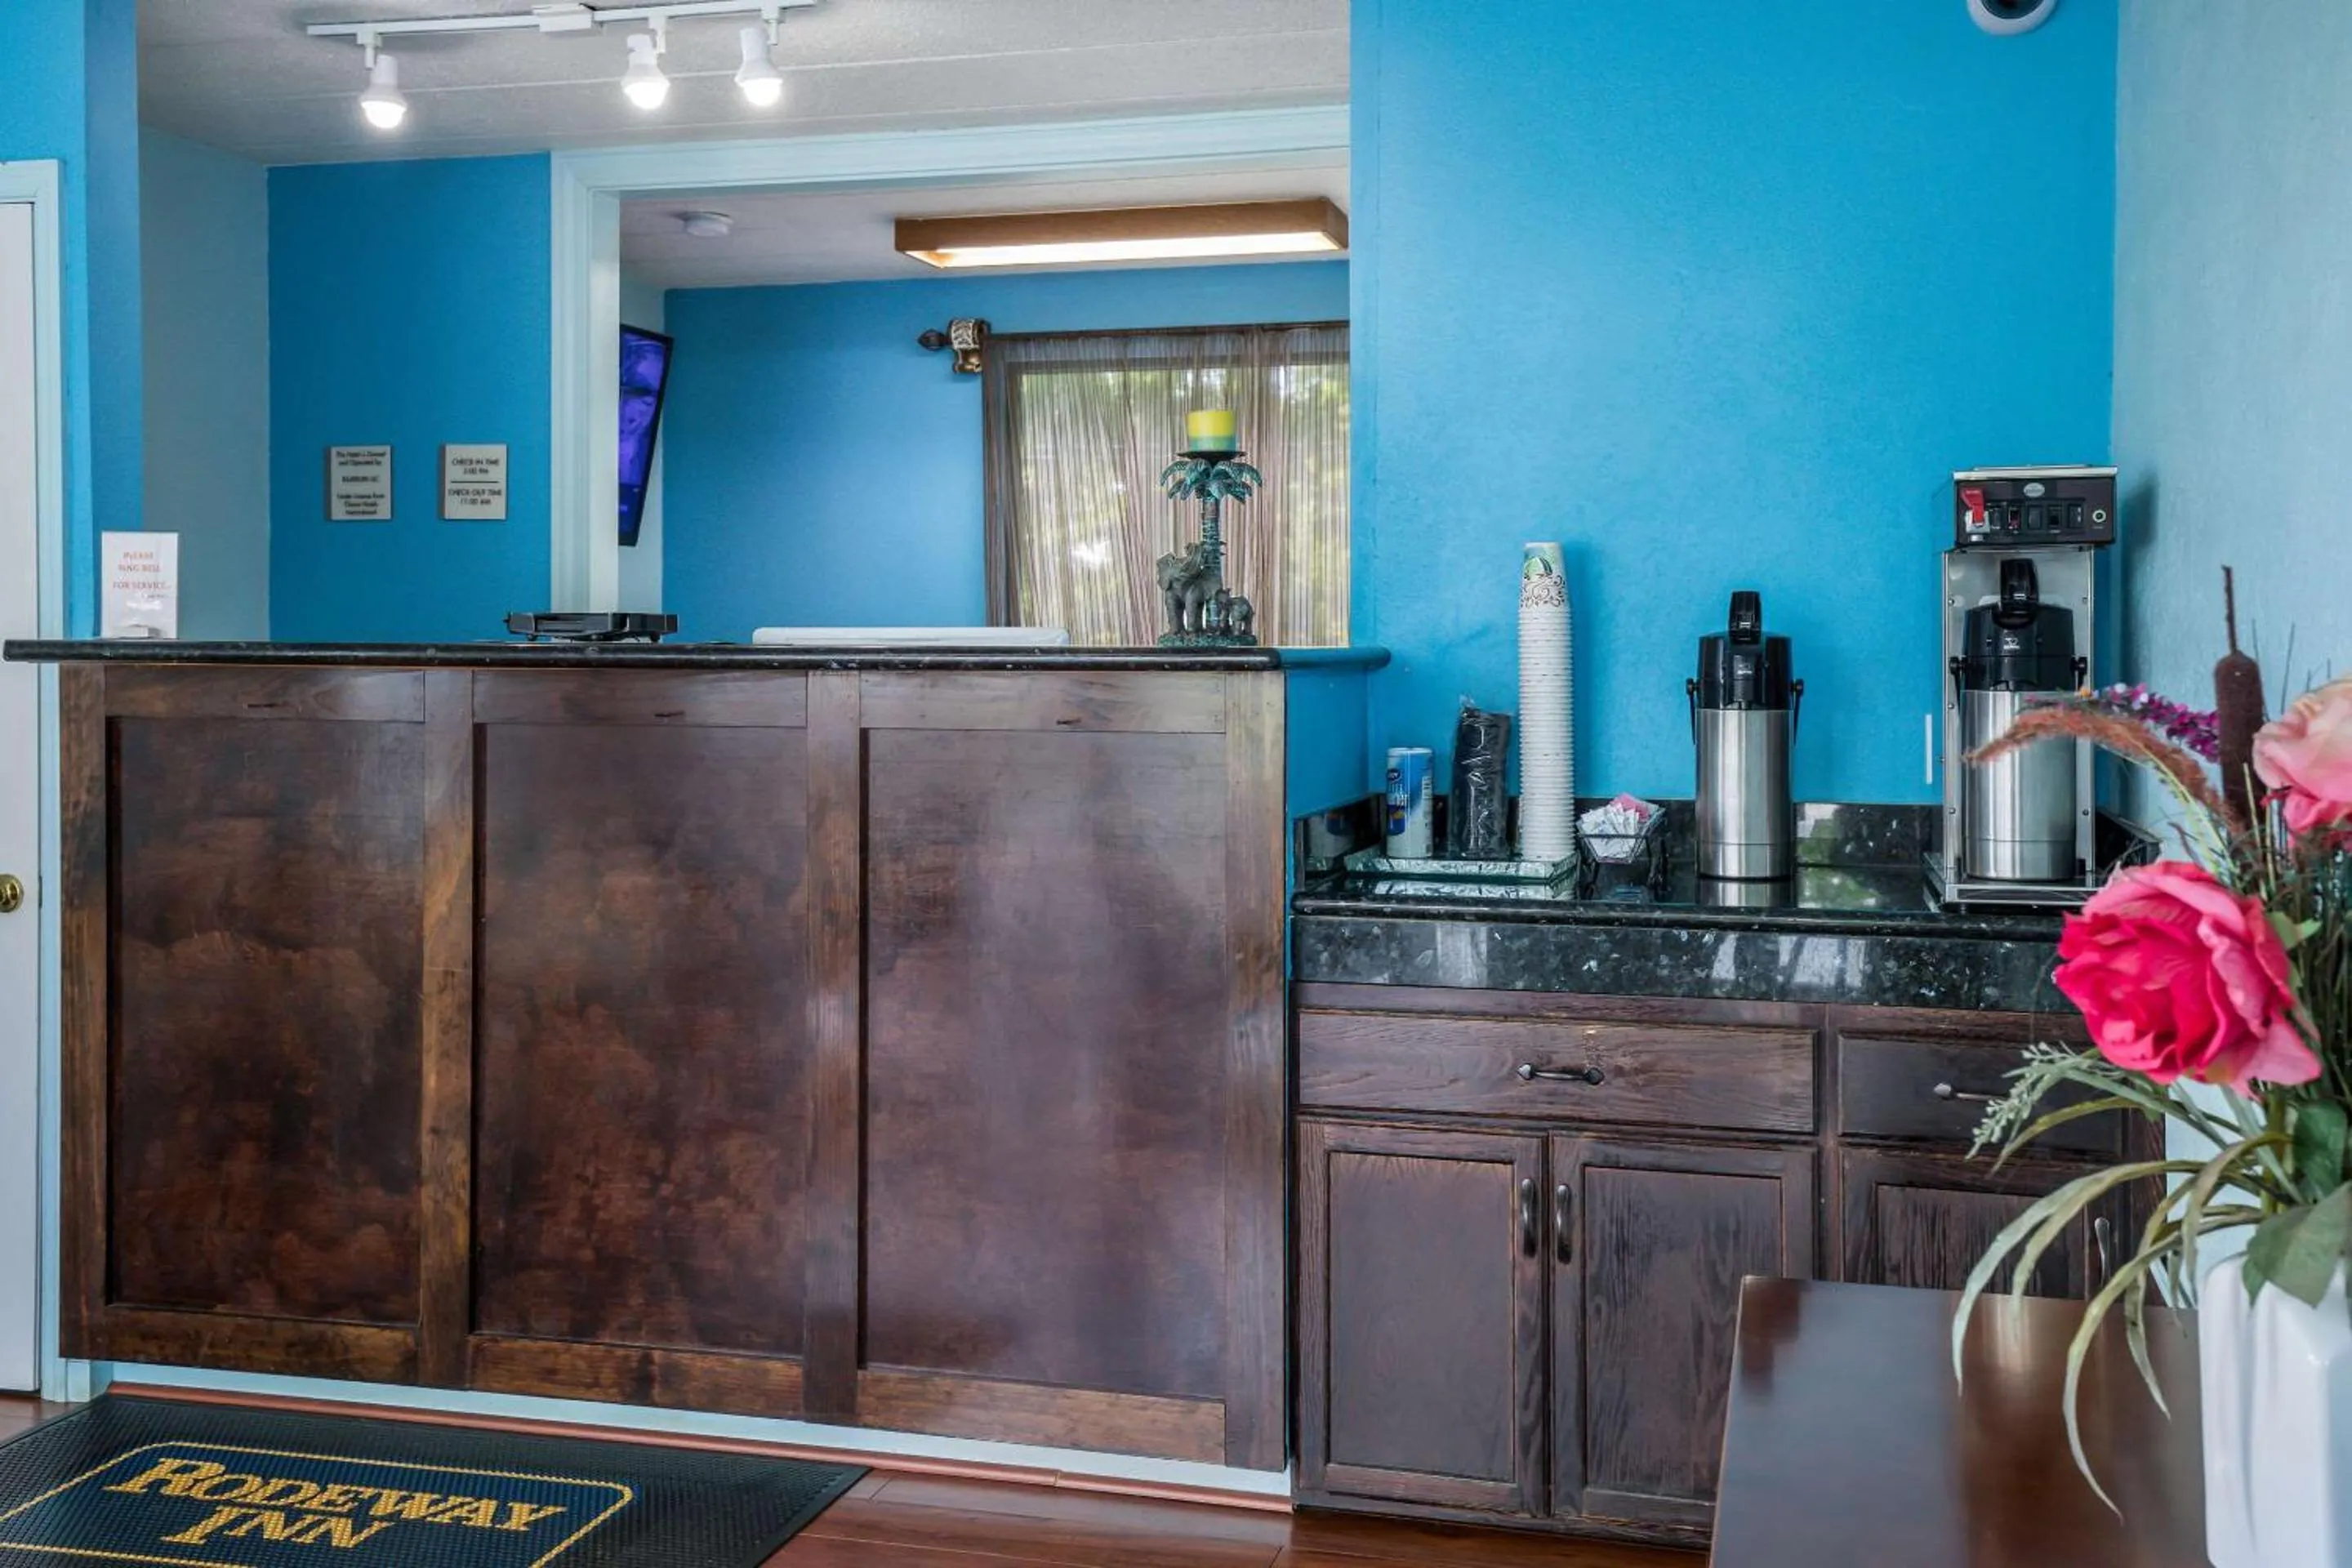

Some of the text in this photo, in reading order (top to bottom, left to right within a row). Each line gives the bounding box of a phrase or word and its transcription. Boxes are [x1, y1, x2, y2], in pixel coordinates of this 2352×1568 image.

[113, 581, 130, 589] FOR
[104, 1458, 565, 1531] RODEWAY
[160, 1505, 393, 1548] INN
